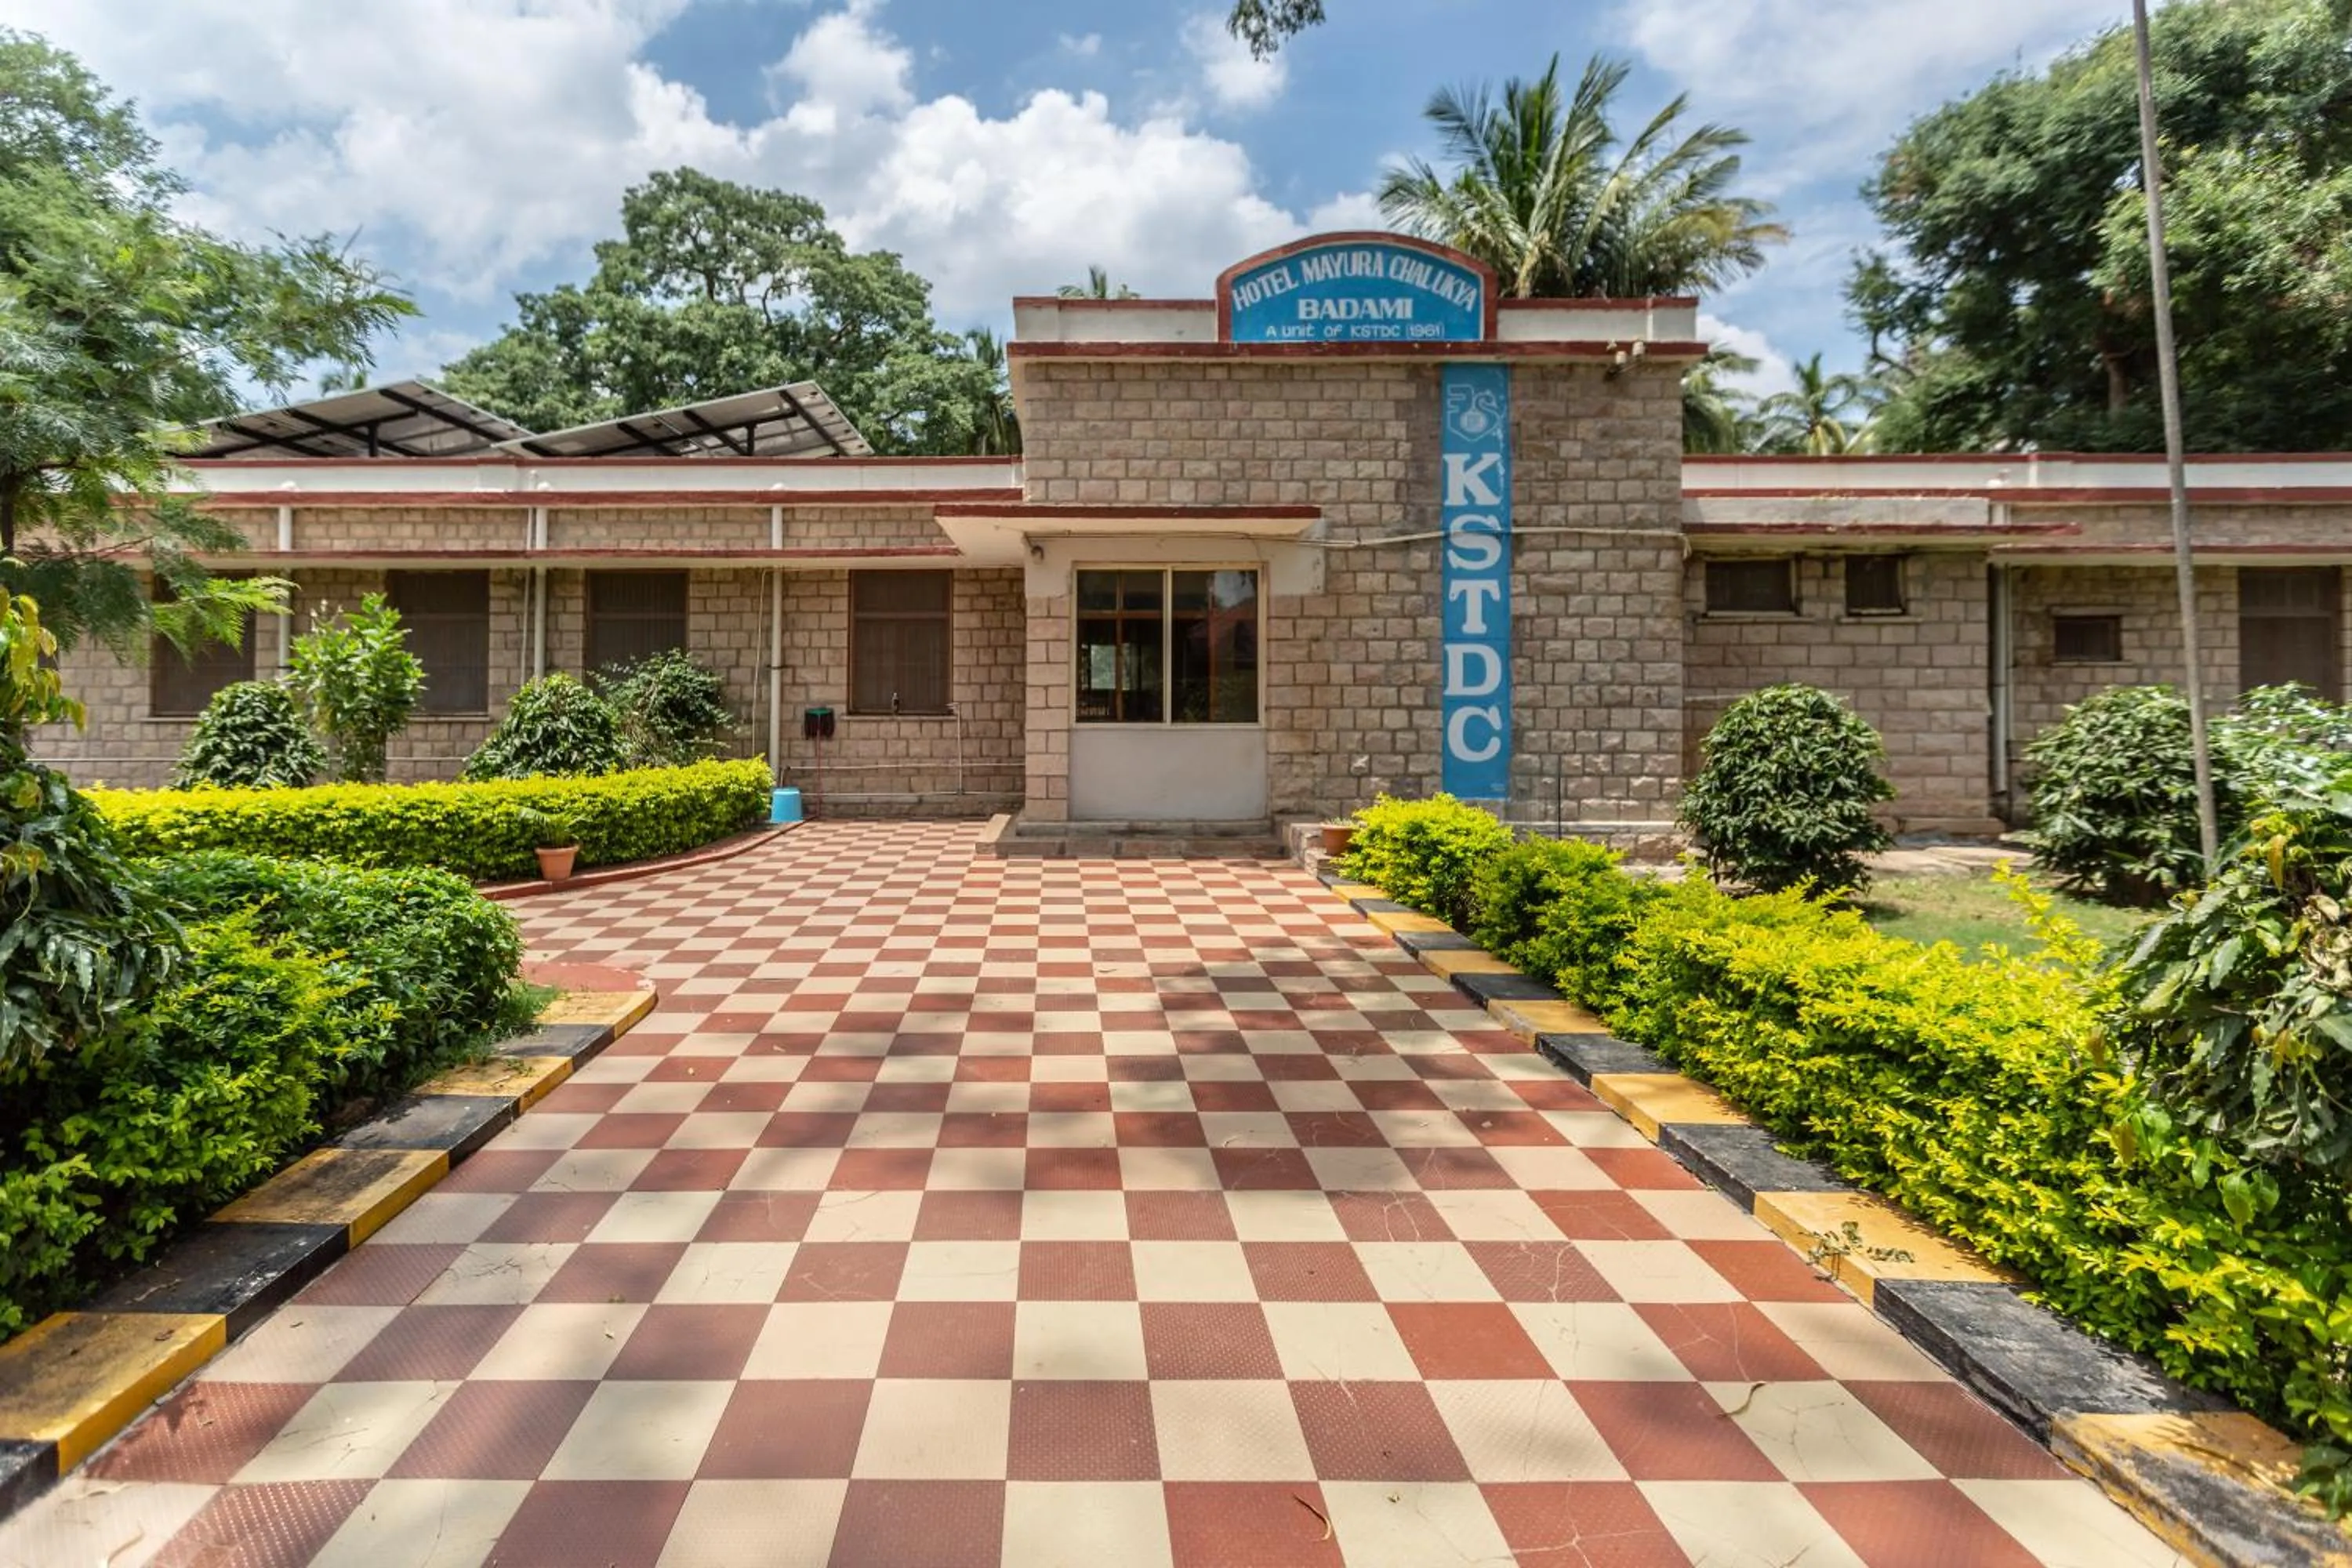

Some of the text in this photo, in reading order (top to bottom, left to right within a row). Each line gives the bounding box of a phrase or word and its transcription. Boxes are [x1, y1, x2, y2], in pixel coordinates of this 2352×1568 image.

[1232, 251, 1477, 312] HOTEL MAYURA CHALUKYA
[1298, 297, 1414, 320] BADAMI
[1266, 325, 1276, 337] A
[1351, 325, 1400, 337] KSTDC
[1443, 452, 1502, 762] KSTDC
